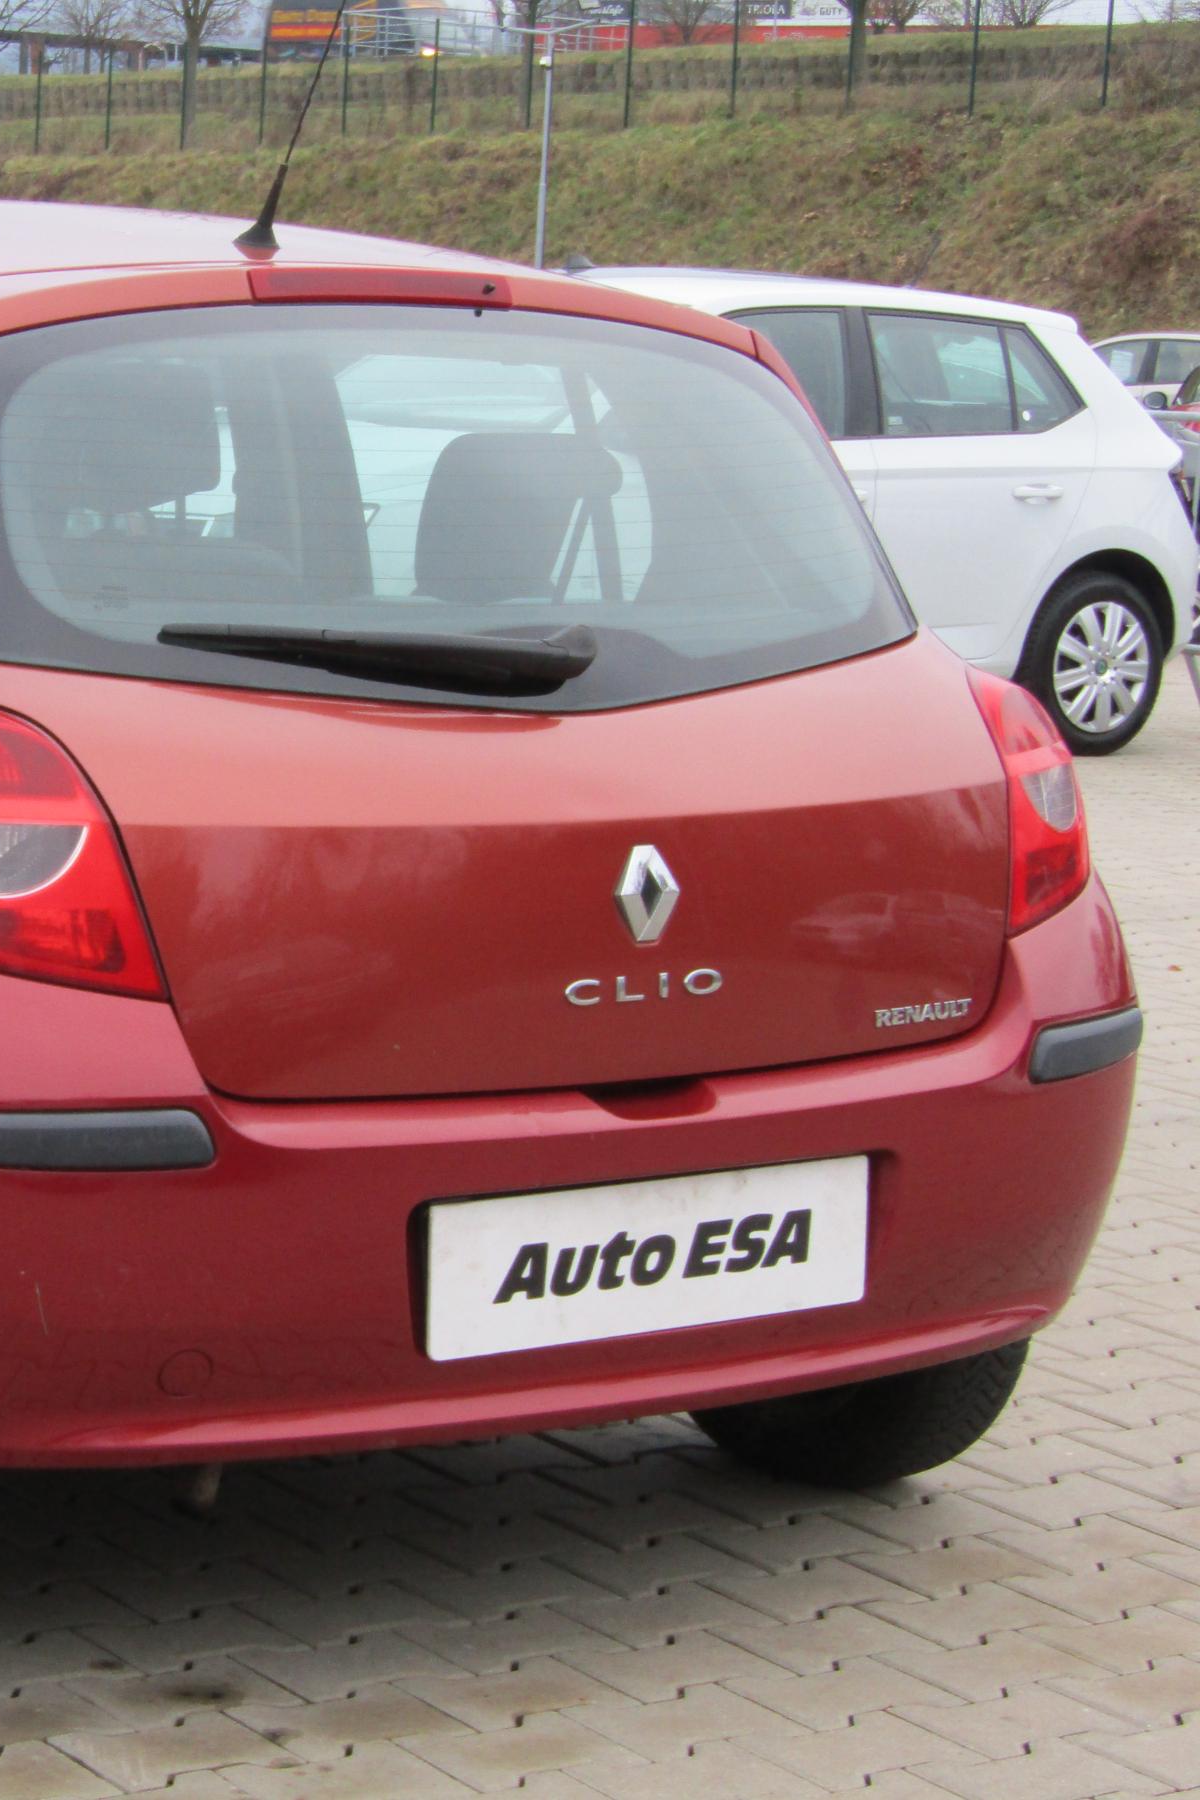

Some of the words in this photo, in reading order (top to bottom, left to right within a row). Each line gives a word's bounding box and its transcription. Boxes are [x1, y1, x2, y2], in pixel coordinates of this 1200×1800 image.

[564, 968, 722, 1007] CLIO
[874, 999, 972, 1028] RENAULT
[492, 1231, 676, 1304] Auto
[682, 1208, 812, 1279] ESA
